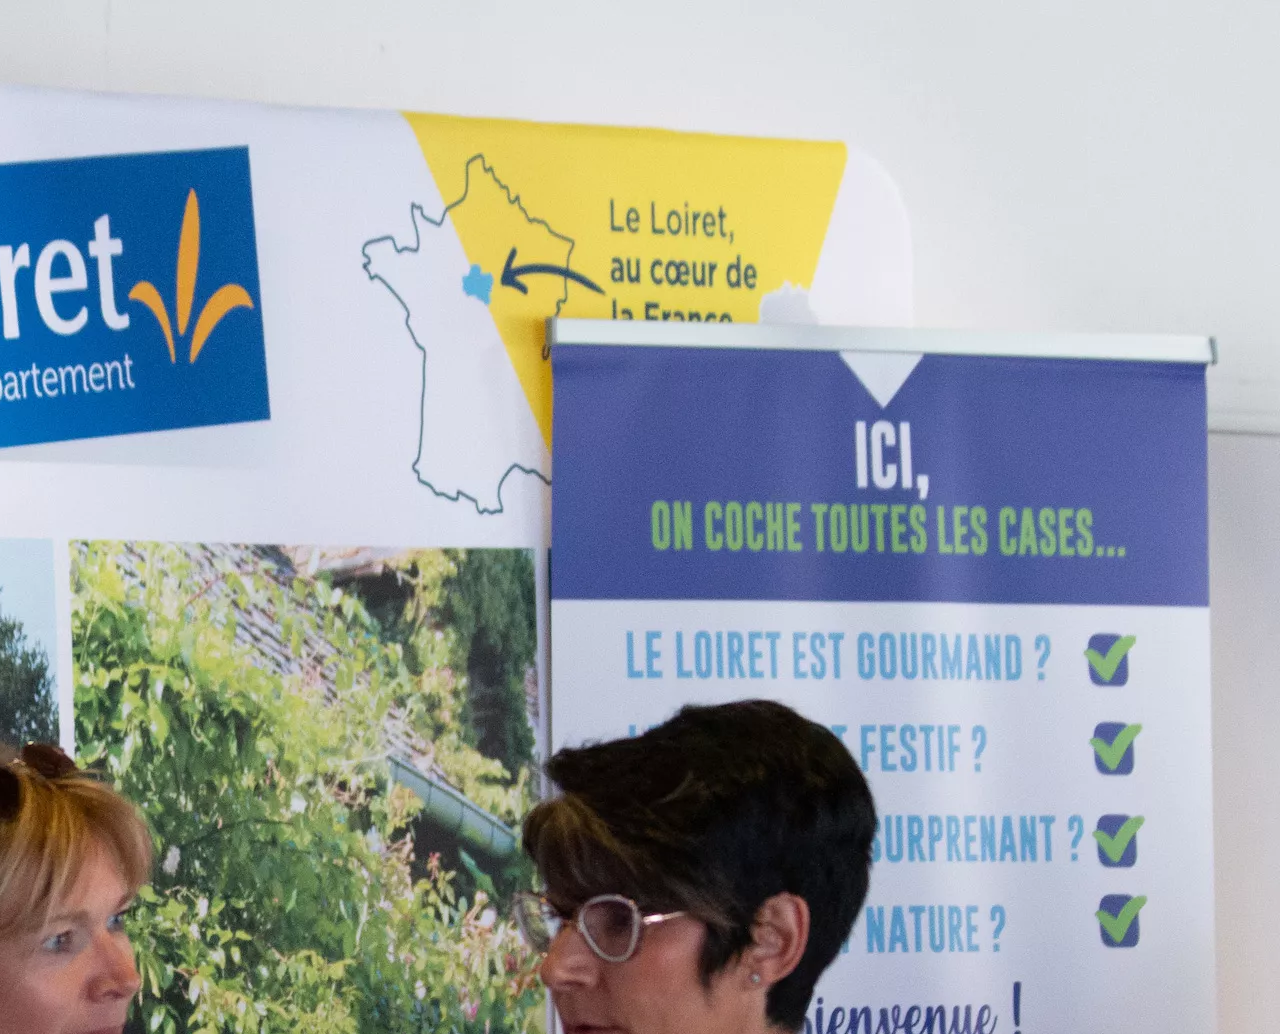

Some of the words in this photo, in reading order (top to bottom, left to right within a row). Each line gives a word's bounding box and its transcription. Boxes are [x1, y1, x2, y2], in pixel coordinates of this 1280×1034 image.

[609, 198, 640, 234] Le
[650, 200, 735, 245] Loiret,
[610, 256, 641, 285] au
[650, 257, 718, 289] cœur
[726, 254, 758, 290] de
[855, 420, 930, 500] ICI,
[650, 500, 693, 551] ON
[705, 501, 804, 553] COCHE
[810, 503, 928, 555] TOUTES
[936, 505, 989, 556] LES
[998, 506, 1128, 558] CASES...
[625, 630, 663, 680] LE
[675, 630, 783, 680] LOIRET
[792, 631, 845, 681] EST
[856, 632, 1023, 682] GOURMAND
[1033, 634, 1053, 683] ?
[859, 724, 963, 773] FESTIF
[970, 725, 989, 773] ?
[1066, 814, 1086, 864] ?
[865, 904, 981, 954] NATURE
[989, 905, 1008, 954] ?
